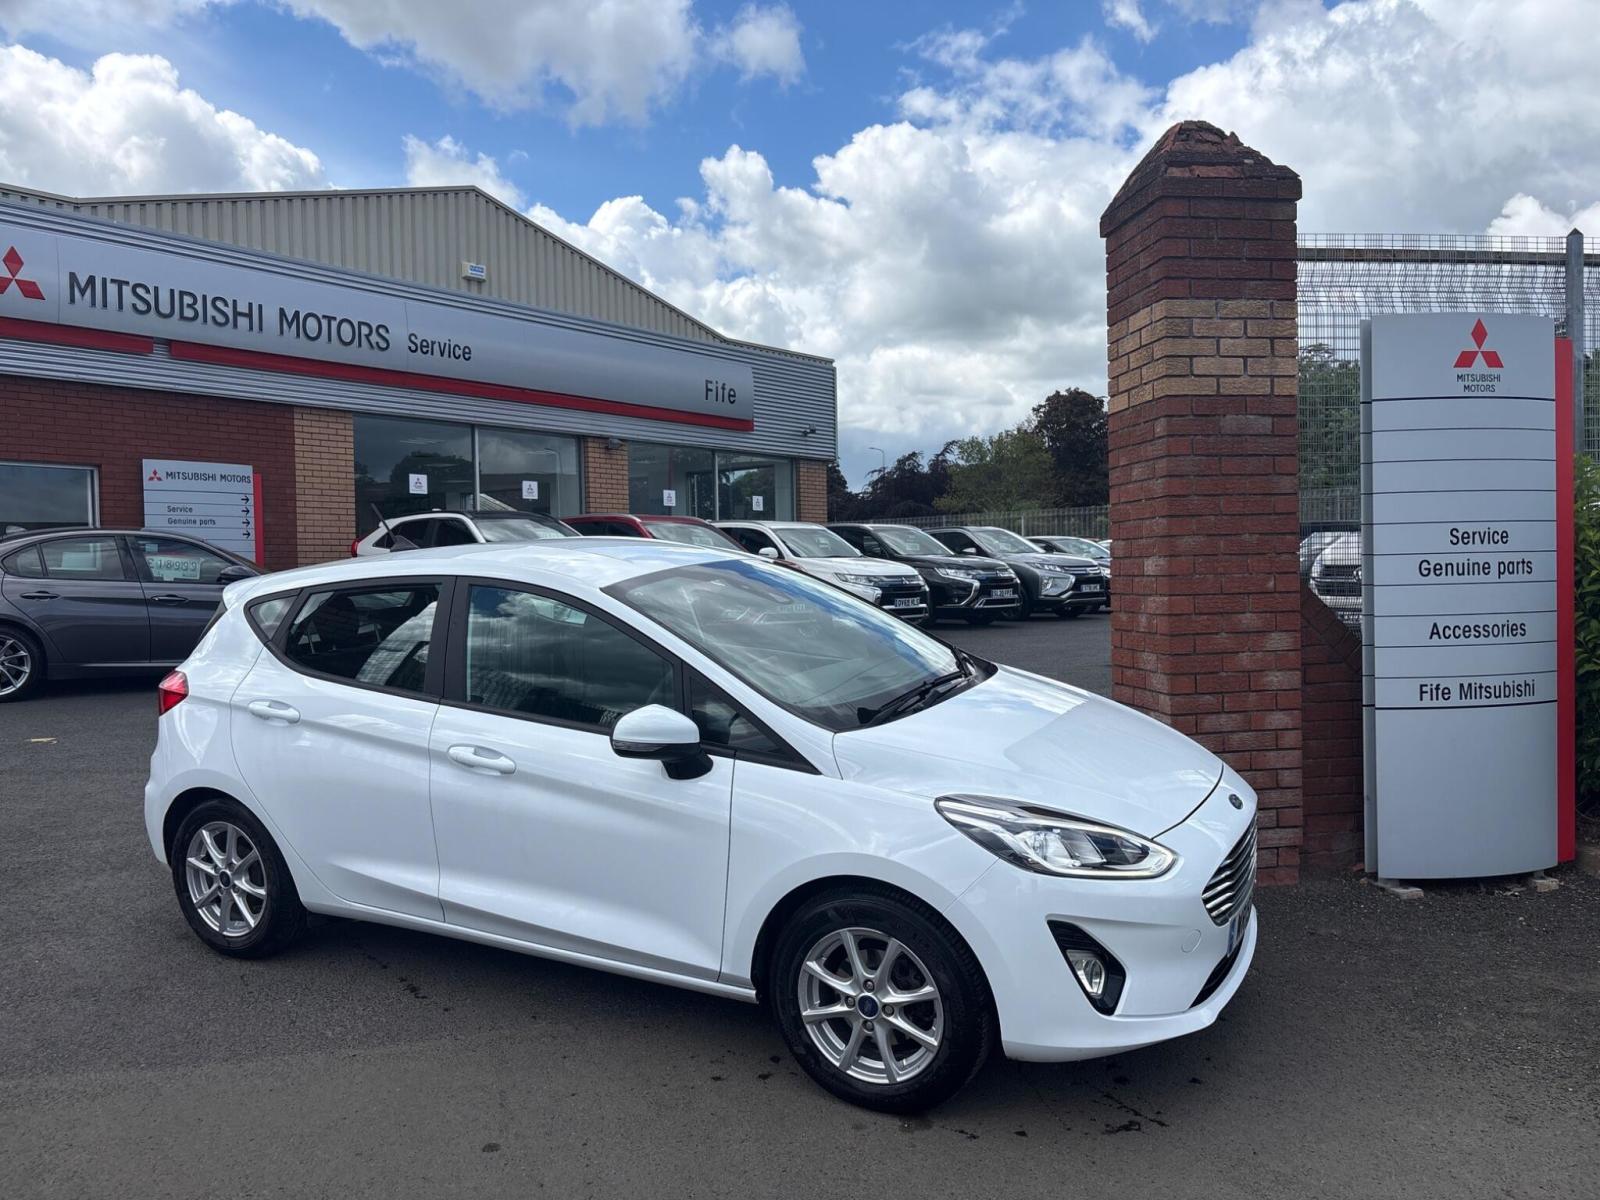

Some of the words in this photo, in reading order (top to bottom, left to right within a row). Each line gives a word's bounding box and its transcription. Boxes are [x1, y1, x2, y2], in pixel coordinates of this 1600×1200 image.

[68, 271, 263, 332] MITSUBISHI
[279, 306, 391, 352] MOTORS
[407, 333, 472, 361] Service
[1456, 373, 1501, 383] MITSUBISHI
[705, 379, 736, 405] Fife
[1463, 383, 1496, 393] MOTORS
[165, 471, 217, 482] MITSUBISHI
[220, 474, 252, 484] MOTORS
[167, 505, 193, 513] Service
[168, 517, 197, 525] Genuine
[199, 518, 216, 526] parts
[1449, 527, 1509, 546] Service
[1418, 558, 1491, 578] Genuine
[1497, 557, 1533, 579] parts
[1429, 620, 1527, 640] Accessories
[1418, 683, 1452, 701] Fife
[1459, 679, 1535, 701] Mitsubishi
